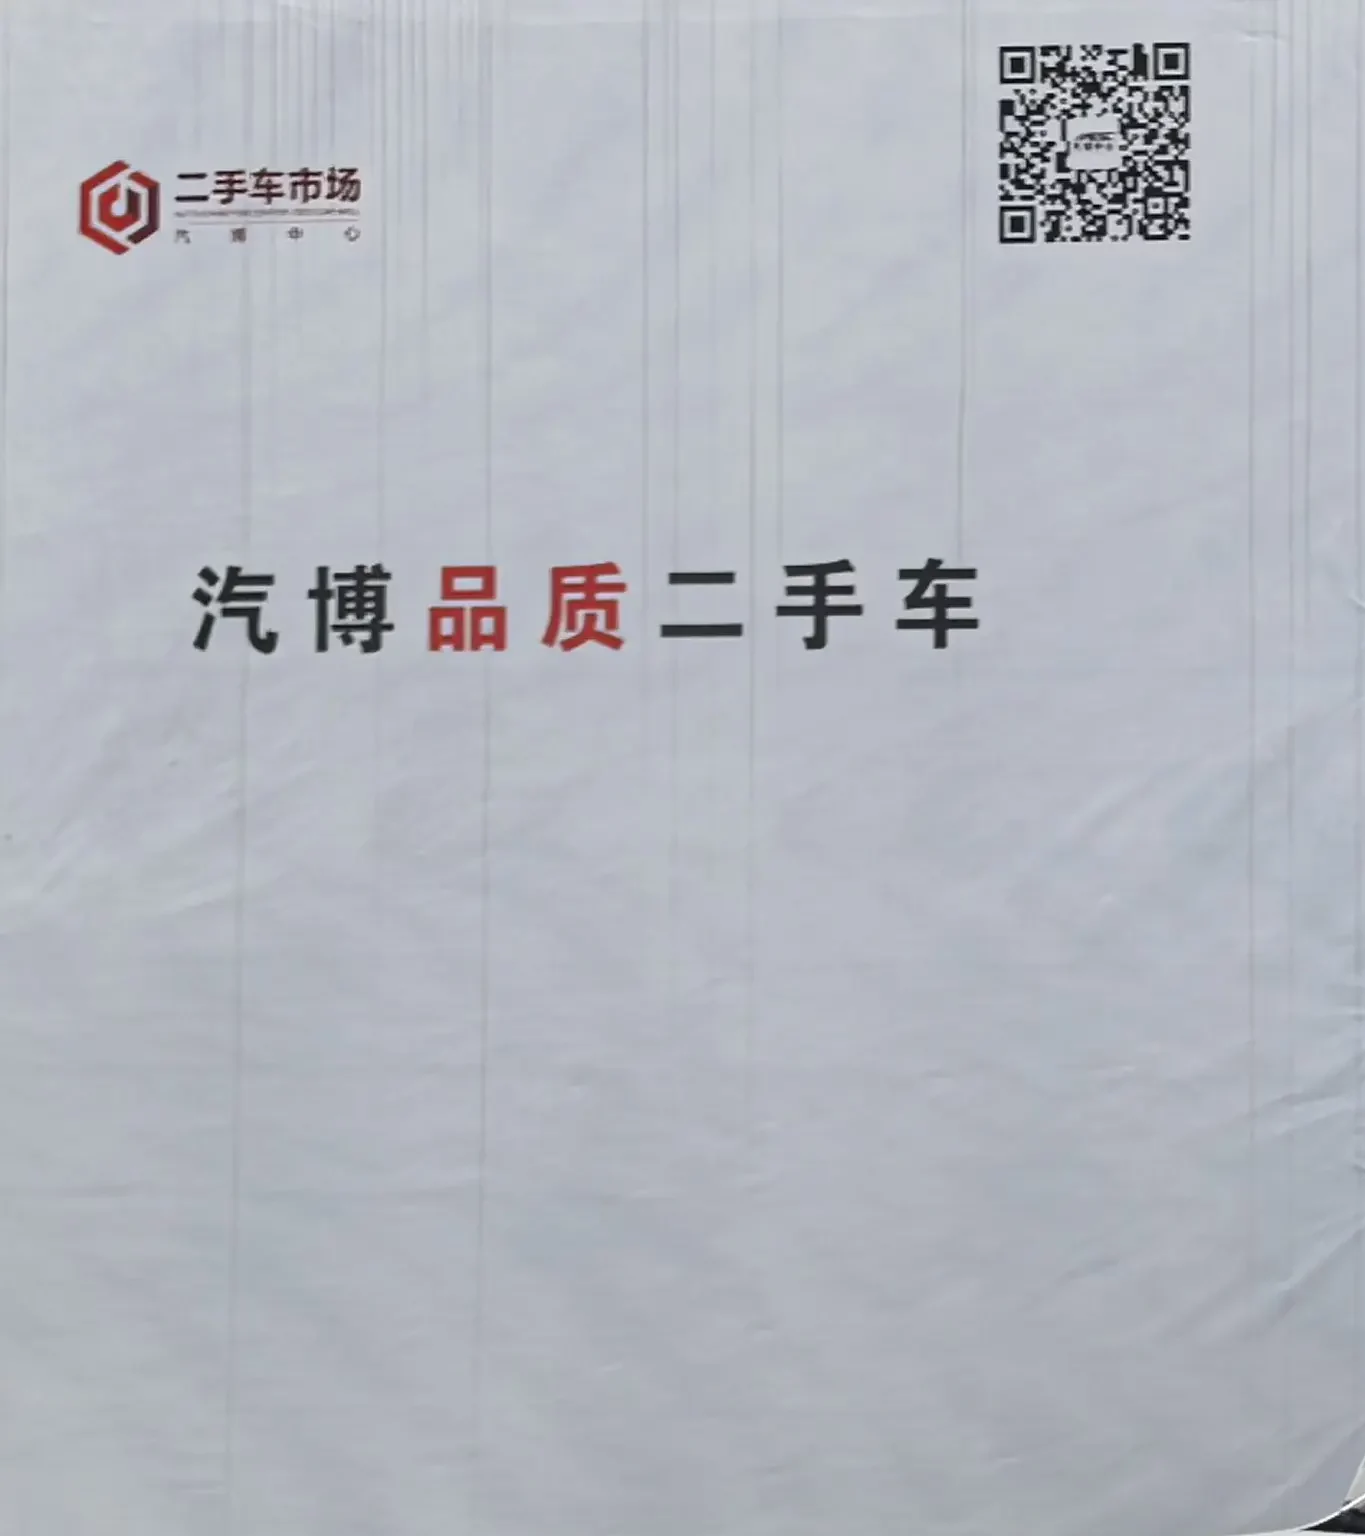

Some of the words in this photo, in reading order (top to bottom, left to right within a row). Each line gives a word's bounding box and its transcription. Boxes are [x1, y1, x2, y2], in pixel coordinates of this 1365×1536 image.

[174, 166, 361, 205] 二手车市场
[192, 557, 981, 654] 汽博品质二手车
